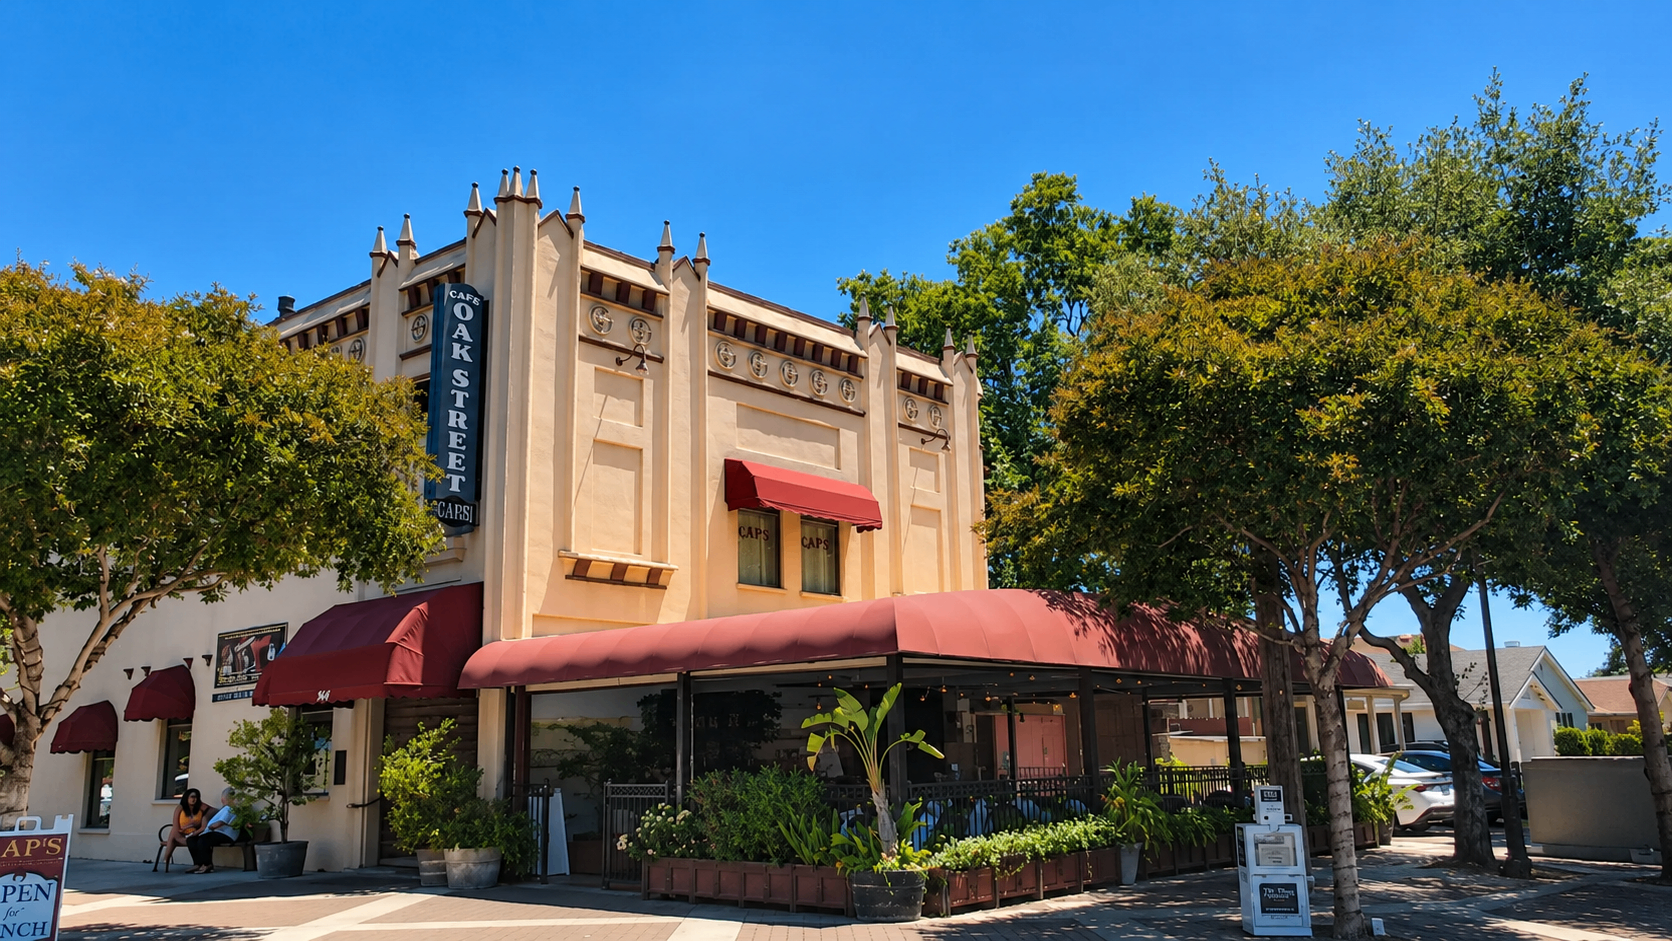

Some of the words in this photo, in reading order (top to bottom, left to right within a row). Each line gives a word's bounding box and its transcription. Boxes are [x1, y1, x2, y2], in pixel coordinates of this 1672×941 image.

[450, 302, 474, 363] OAK
[446, 368, 470, 493] STREET
[738, 525, 769, 541] CAPS
[801, 535, 829, 550] CAPS
[0, 838, 62, 858] AP'S
[0, 882, 54, 904] PEN
[3, 906, 23, 921] for
[0, 921, 48, 939] NCH
